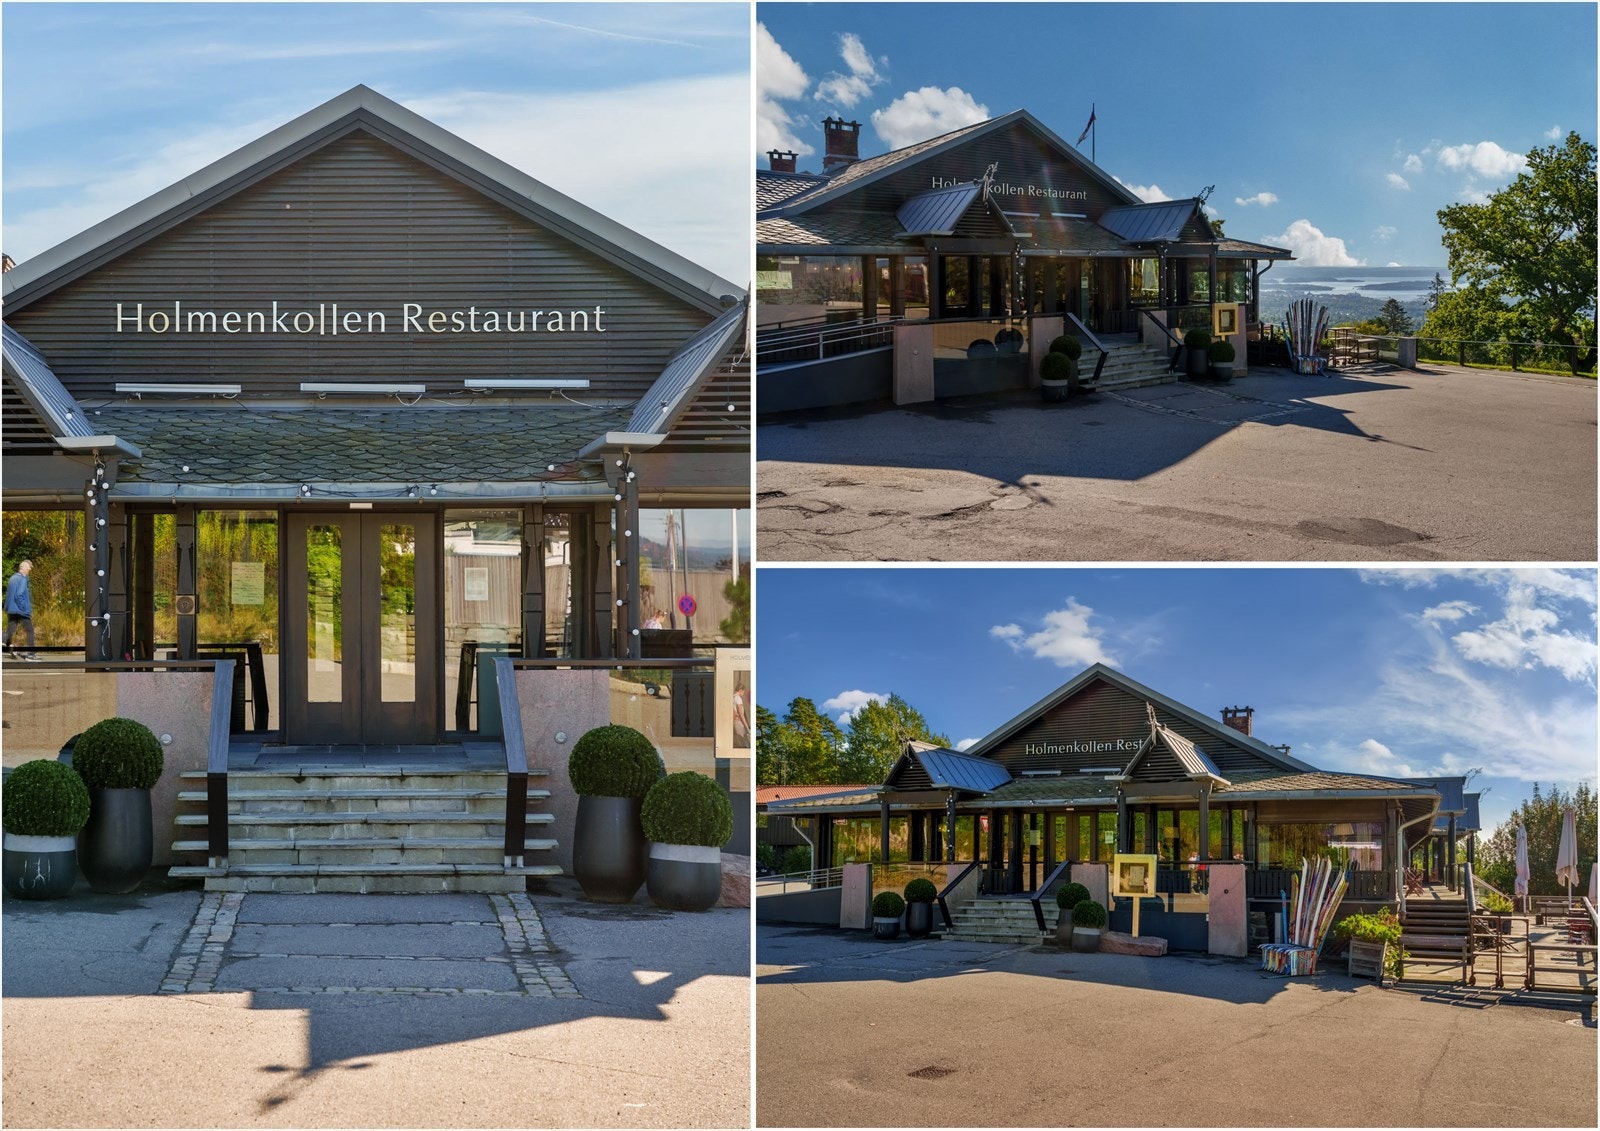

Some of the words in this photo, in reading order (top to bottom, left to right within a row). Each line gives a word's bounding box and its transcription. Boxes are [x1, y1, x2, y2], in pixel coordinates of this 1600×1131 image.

[932, 177, 1024, 196] Holkollen
[1028, 185, 1087, 200] Restaurant
[116, 301, 386, 336] Holmenkollen
[402, 303, 606, 333] Restaurant
[1025, 740, 1112, 755] Holmenkollen
[1116, 739, 1145, 751] Rest
